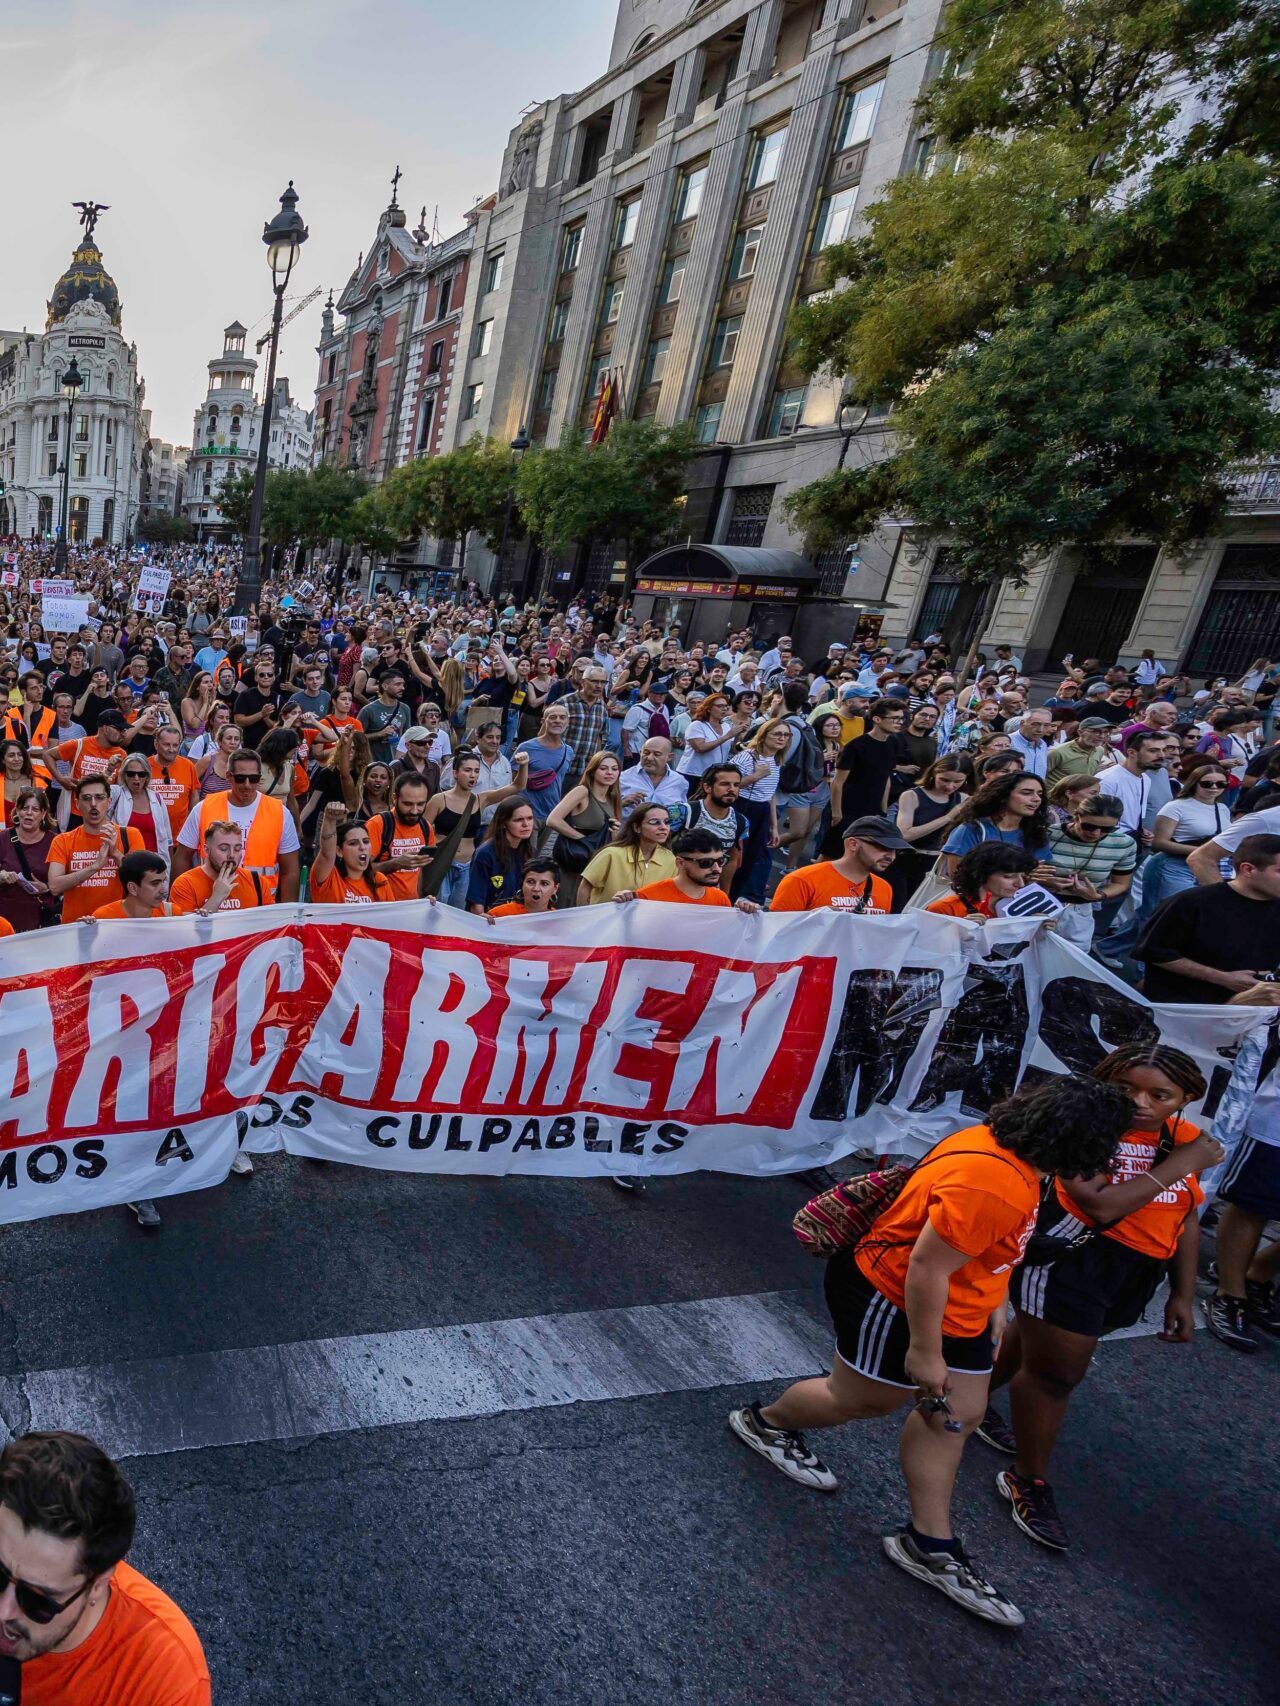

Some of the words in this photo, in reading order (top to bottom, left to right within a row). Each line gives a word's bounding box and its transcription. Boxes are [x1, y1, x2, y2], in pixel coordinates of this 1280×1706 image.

[70, 338, 104, 346] METROPOLIS
[143, 569, 170, 581] CULPABLES
[393, 837, 421, 846] SINDICATO
[72, 861, 80, 869] DE
[81, 879, 109, 887] MADRID
[155, 1128, 195, 1166] A
[366, 1113, 690, 1155] CULPABLES
